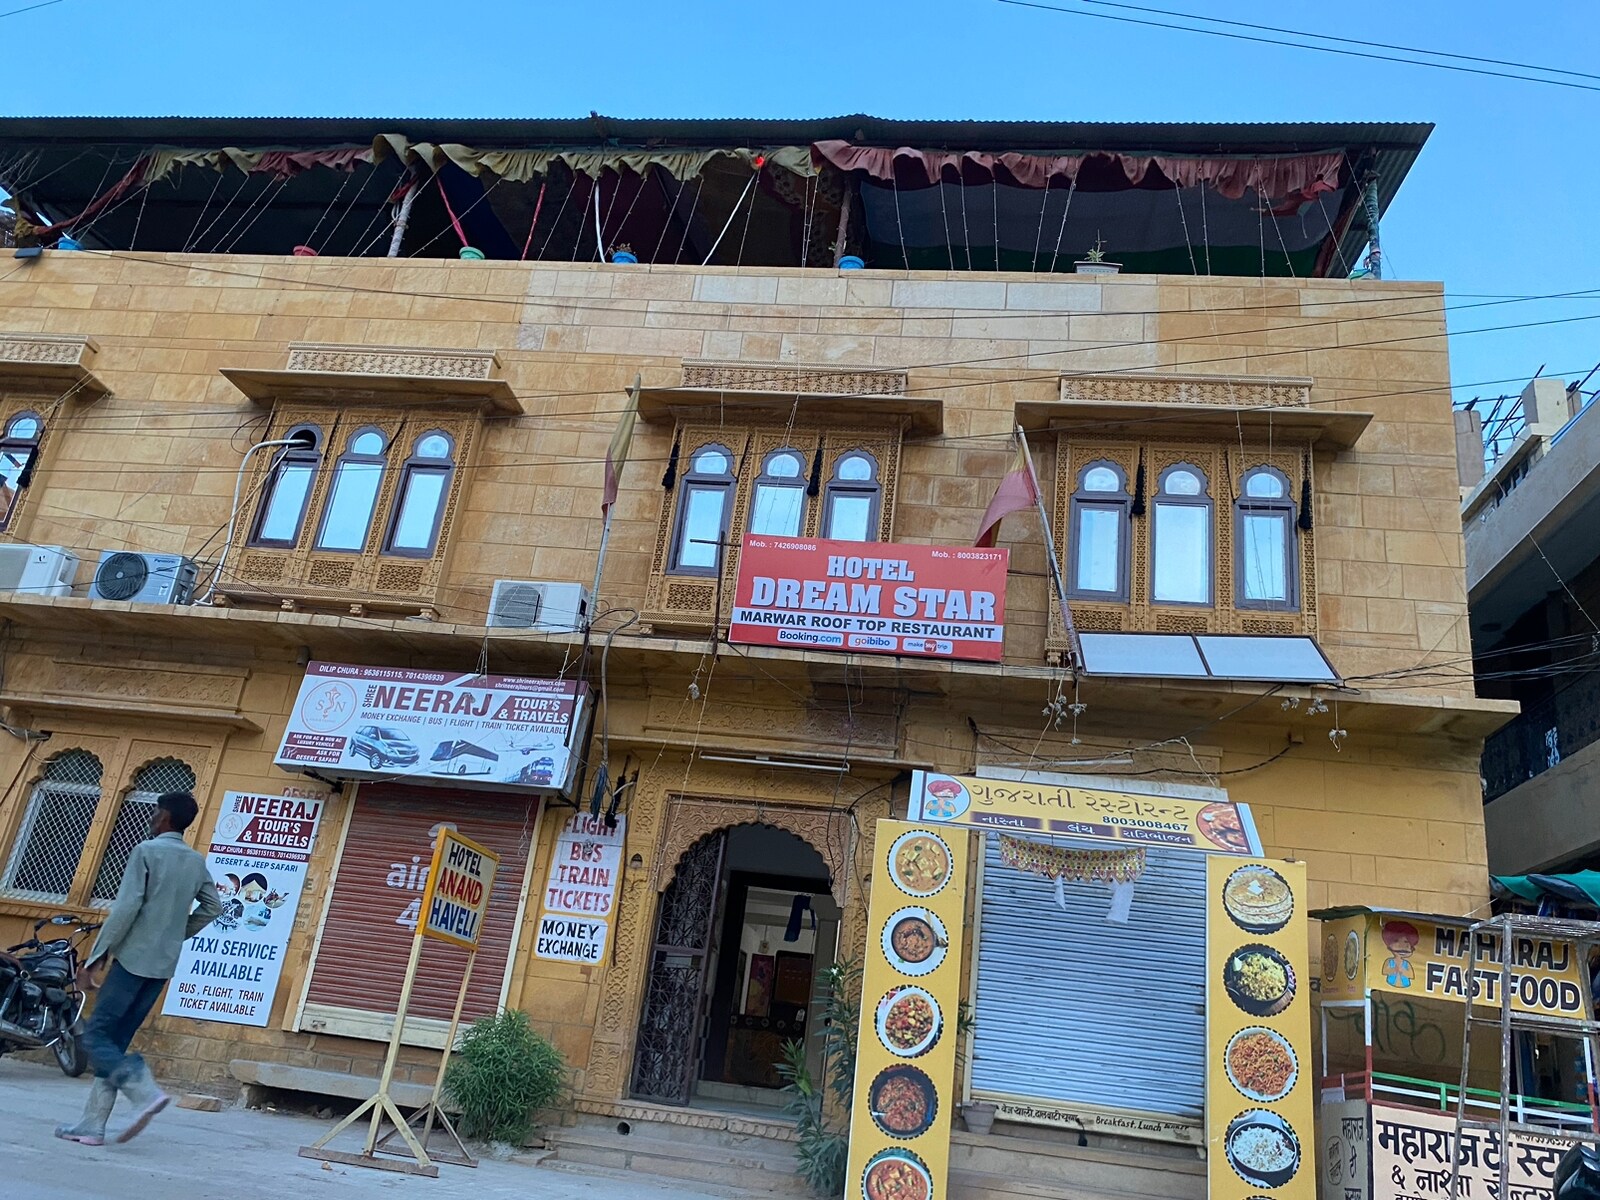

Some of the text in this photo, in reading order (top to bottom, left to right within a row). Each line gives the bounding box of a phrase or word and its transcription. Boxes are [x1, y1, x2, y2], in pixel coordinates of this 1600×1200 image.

[749, 539, 768, 548] Mob.
[931, 550, 951, 559] Mob.
[956, 551, 1002, 561] 8003823171
[826, 555, 915, 582] HOTEL
[749, 576, 996, 622] DREAM STAR
[740, 610, 995, 639] MARWAR ROOF TOP RESTAURANT
[779, 630, 842, 644] Booking.com
[854, 635, 891, 647] goibibo
[937, 643, 949, 651] trip
[319, 664, 337, 672] DILIP
[337, 666, 359, 675] CHURA
[362, 684, 377, 708] SHREE
[372, 685, 493, 717] NEERAJ
[513, 698, 561, 711] TOUR'S
[360, 711, 568, 735] MONEY EXCHANGE BUS FLIGHT TRAIN TICKET AVAILABLE
[498, 708, 569, 724] & TRAVELS
[295, 754, 318, 762] DESERT
[232, 795, 242, 813] SHREE
[971, 784, 1076, 809] ગુજરાતી
[239, 796, 320, 820] NEERAJ
[258, 819, 302, 834] TOUR'S
[982, 816, 1025, 827] નાસ્તા
[1067, 822, 1096, 835] લંચ
[1102, 815, 1189, 832] 8003008467
[213, 844, 226, 852] DILIP
[226, 846, 243, 854] CHURA
[243, 830, 309, 848] & TRAVELS
[215, 857, 299, 873] DESERT & JEEP SAFARI
[447, 842, 482, 876] HOTEL
[437, 866, 483, 905] ANAND
[558, 863, 611, 888] TRAIN
[548, 888, 611, 913] TICKETS
[429, 896, 478, 939] HAVELI
[541, 919, 600, 940] MONEY
[190, 936, 278, 961] TAXI SERVICE
[537, 937, 599, 959] EXCHANGE
[190, 959, 264, 982] AVAILABLE
[178, 982, 197, 994] BUS
[202, 985, 234, 1000] FLIGHT,
[239, 989, 265, 1002] TRAIN
[179, 997, 256, 1017] TICKET AVAILABLE
[1095, 1115, 1137, 1129] Breakfast,
[1138, 1120, 1162, 1132] Lunch
[1376, 1119, 1480, 1168] महाराज
[1391, 1164, 1406, 1190] &
